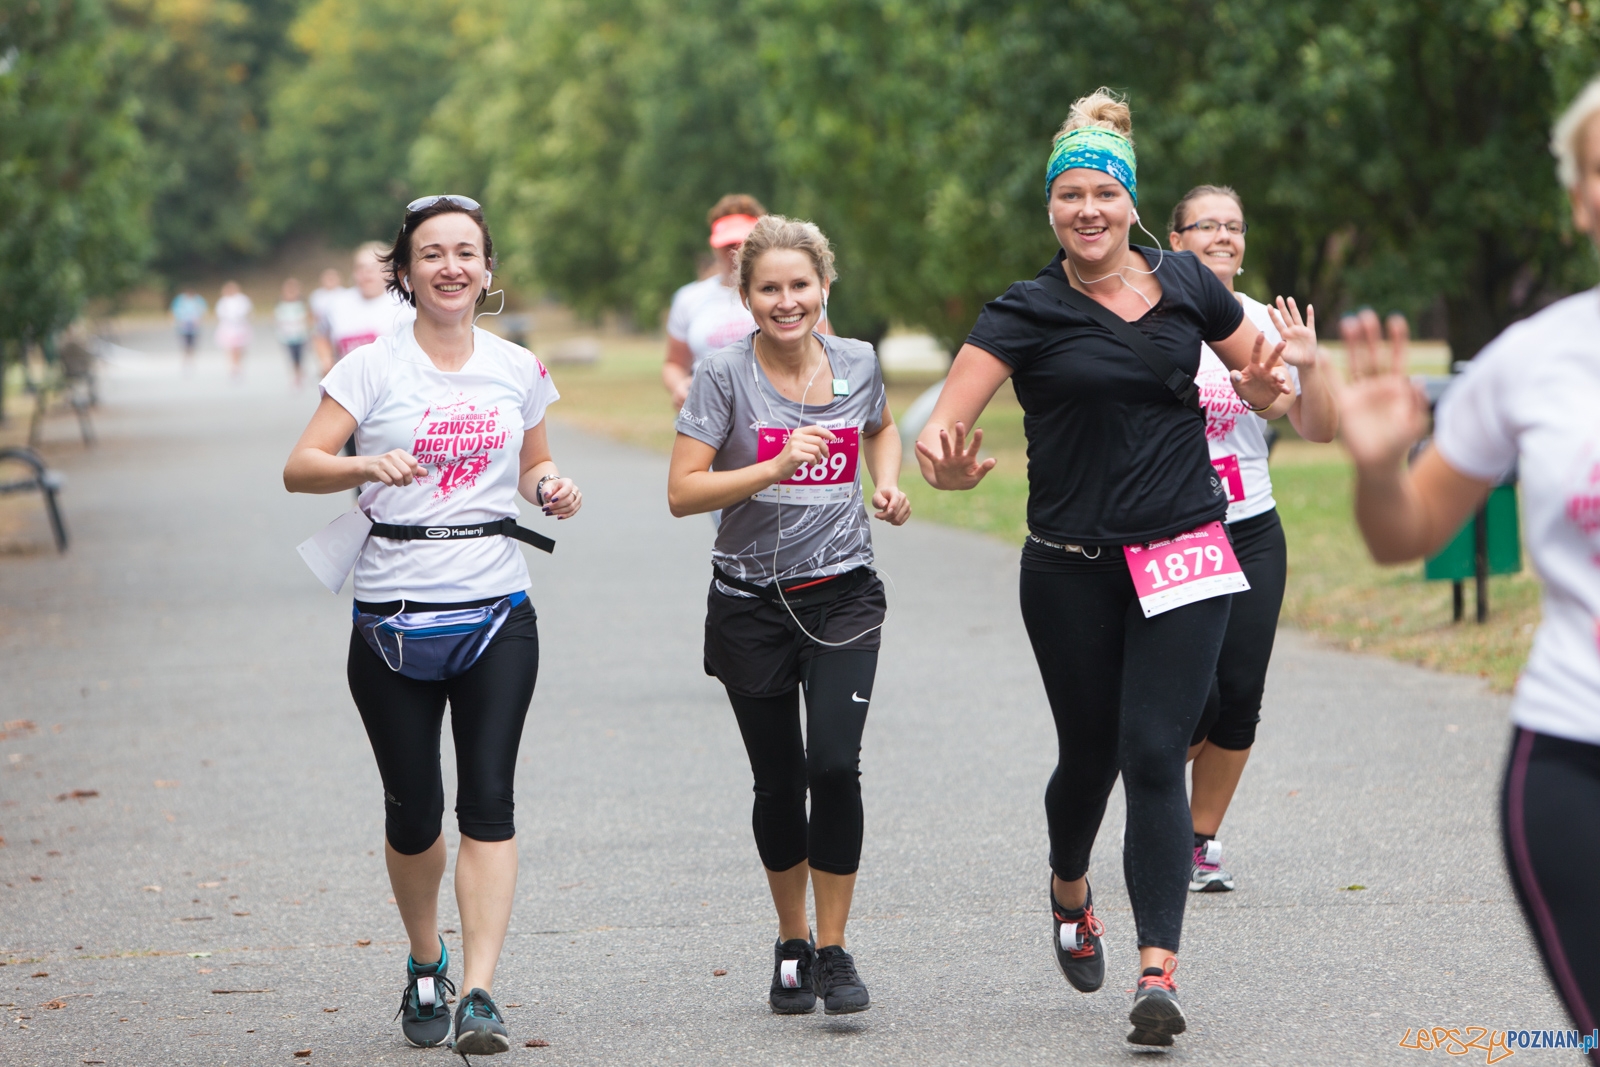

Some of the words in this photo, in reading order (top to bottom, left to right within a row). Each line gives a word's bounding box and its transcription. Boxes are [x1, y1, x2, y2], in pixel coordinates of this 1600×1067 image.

[427, 419, 496, 435] zawsze
[412, 431, 506, 457] pier(w)si!
[417, 453, 447, 464] 2016
[451, 526, 484, 536] Kalenji
[1148, 539, 1171, 550] Zawsze
[1194, 531, 1209, 539] 2016
[1144, 544, 1224, 589] 1879
